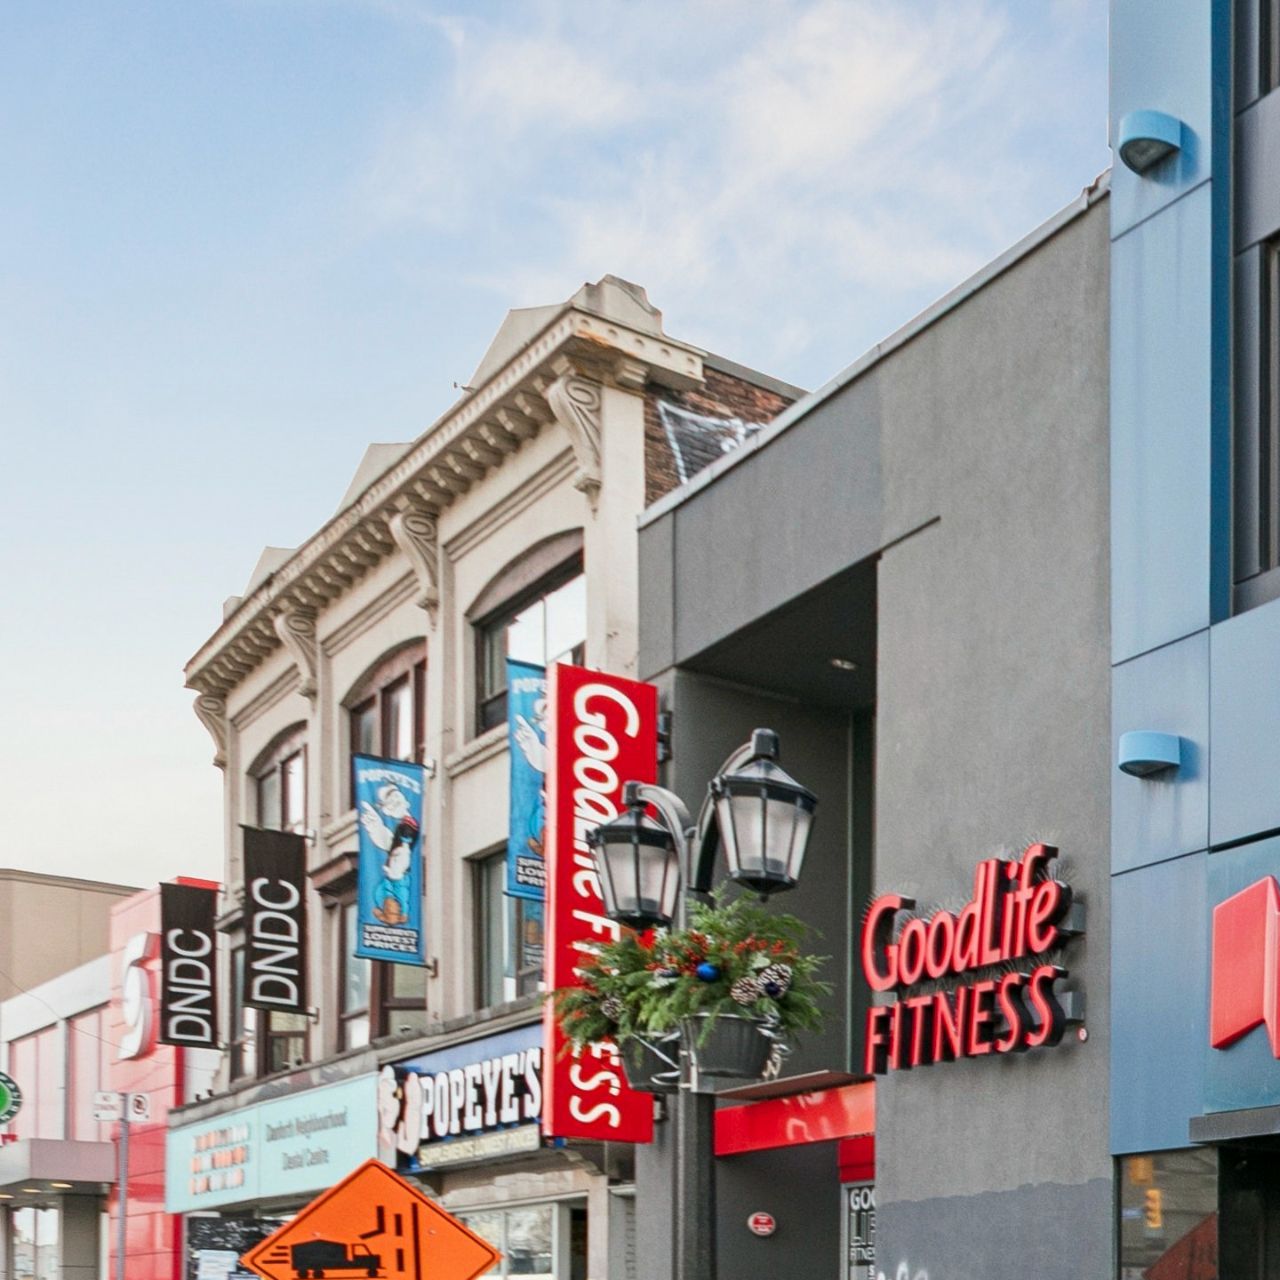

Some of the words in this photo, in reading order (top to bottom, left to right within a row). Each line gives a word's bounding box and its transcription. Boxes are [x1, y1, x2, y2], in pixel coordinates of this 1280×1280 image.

[251, 877, 299, 1006] DNDC
[861, 842, 1067, 992] GoodLife
[167, 929, 212, 1043] DNDC
[569, 909, 621, 1128] FIESS
[865, 965, 1066, 1075] FITNESS
[419, 1047, 543, 1140] POPEYE'S
